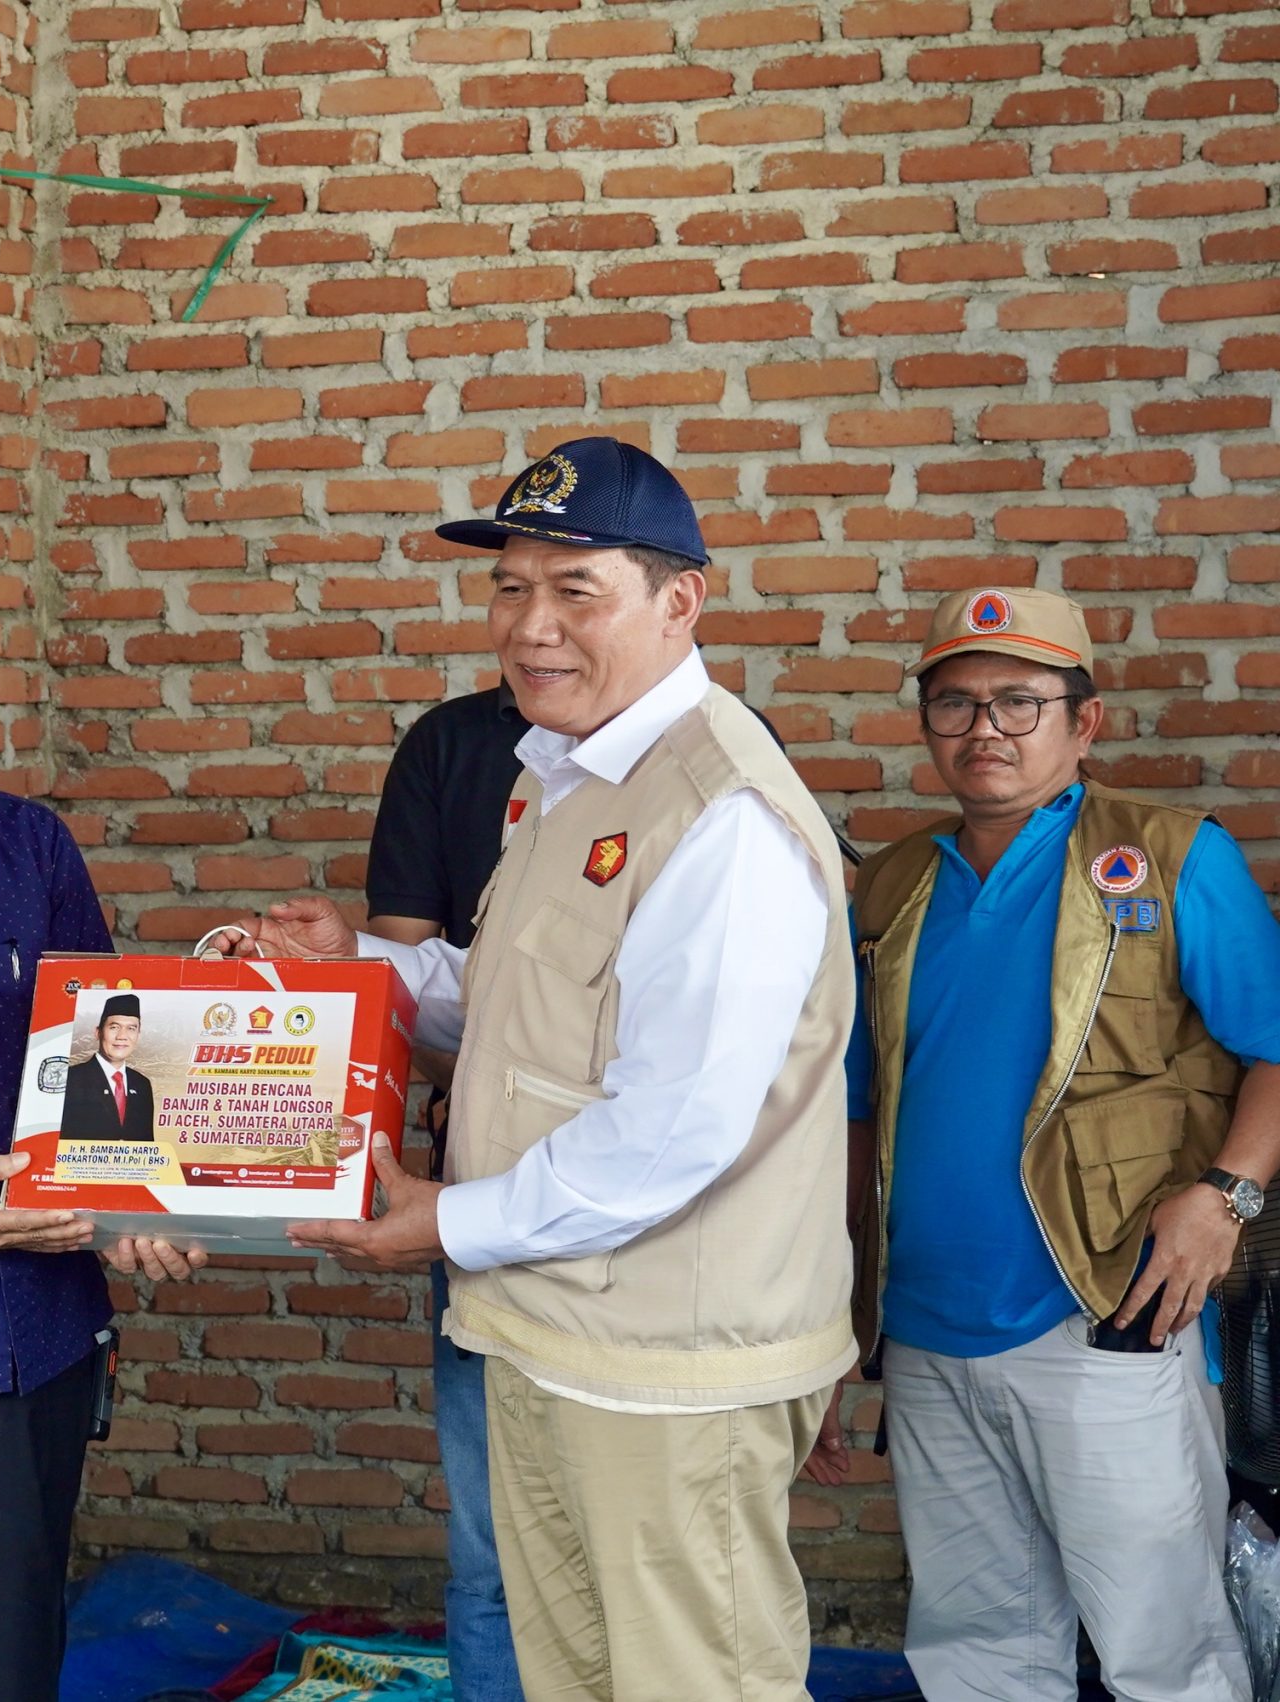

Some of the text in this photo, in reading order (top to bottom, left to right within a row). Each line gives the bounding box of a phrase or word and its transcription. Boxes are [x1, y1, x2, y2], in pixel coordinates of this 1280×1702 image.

[1106, 904, 1152, 926] PB
[193, 1045, 315, 1065] BHS PEDULI
[187, 1082, 312, 1097] MUSIBAH BENCANA
[162, 1098, 333, 1114] BANJIR & TANAH LONGSOR
[158, 1115, 170, 1127] DI
[217, 1116, 287, 1129] SUMATERA
[292, 1117, 333, 1130] UTARA
[179, 1131, 310, 1146] & SUMATERA BARAT
[79, 1145, 87, 1154] H.
[90, 1145, 130, 1154] BAMBANG
[132, 1146, 159, 1155] HARYO
[56, 1155, 111, 1165] SOEKARTONO,
[113, 1156, 141, 1165] M.I.Pol
